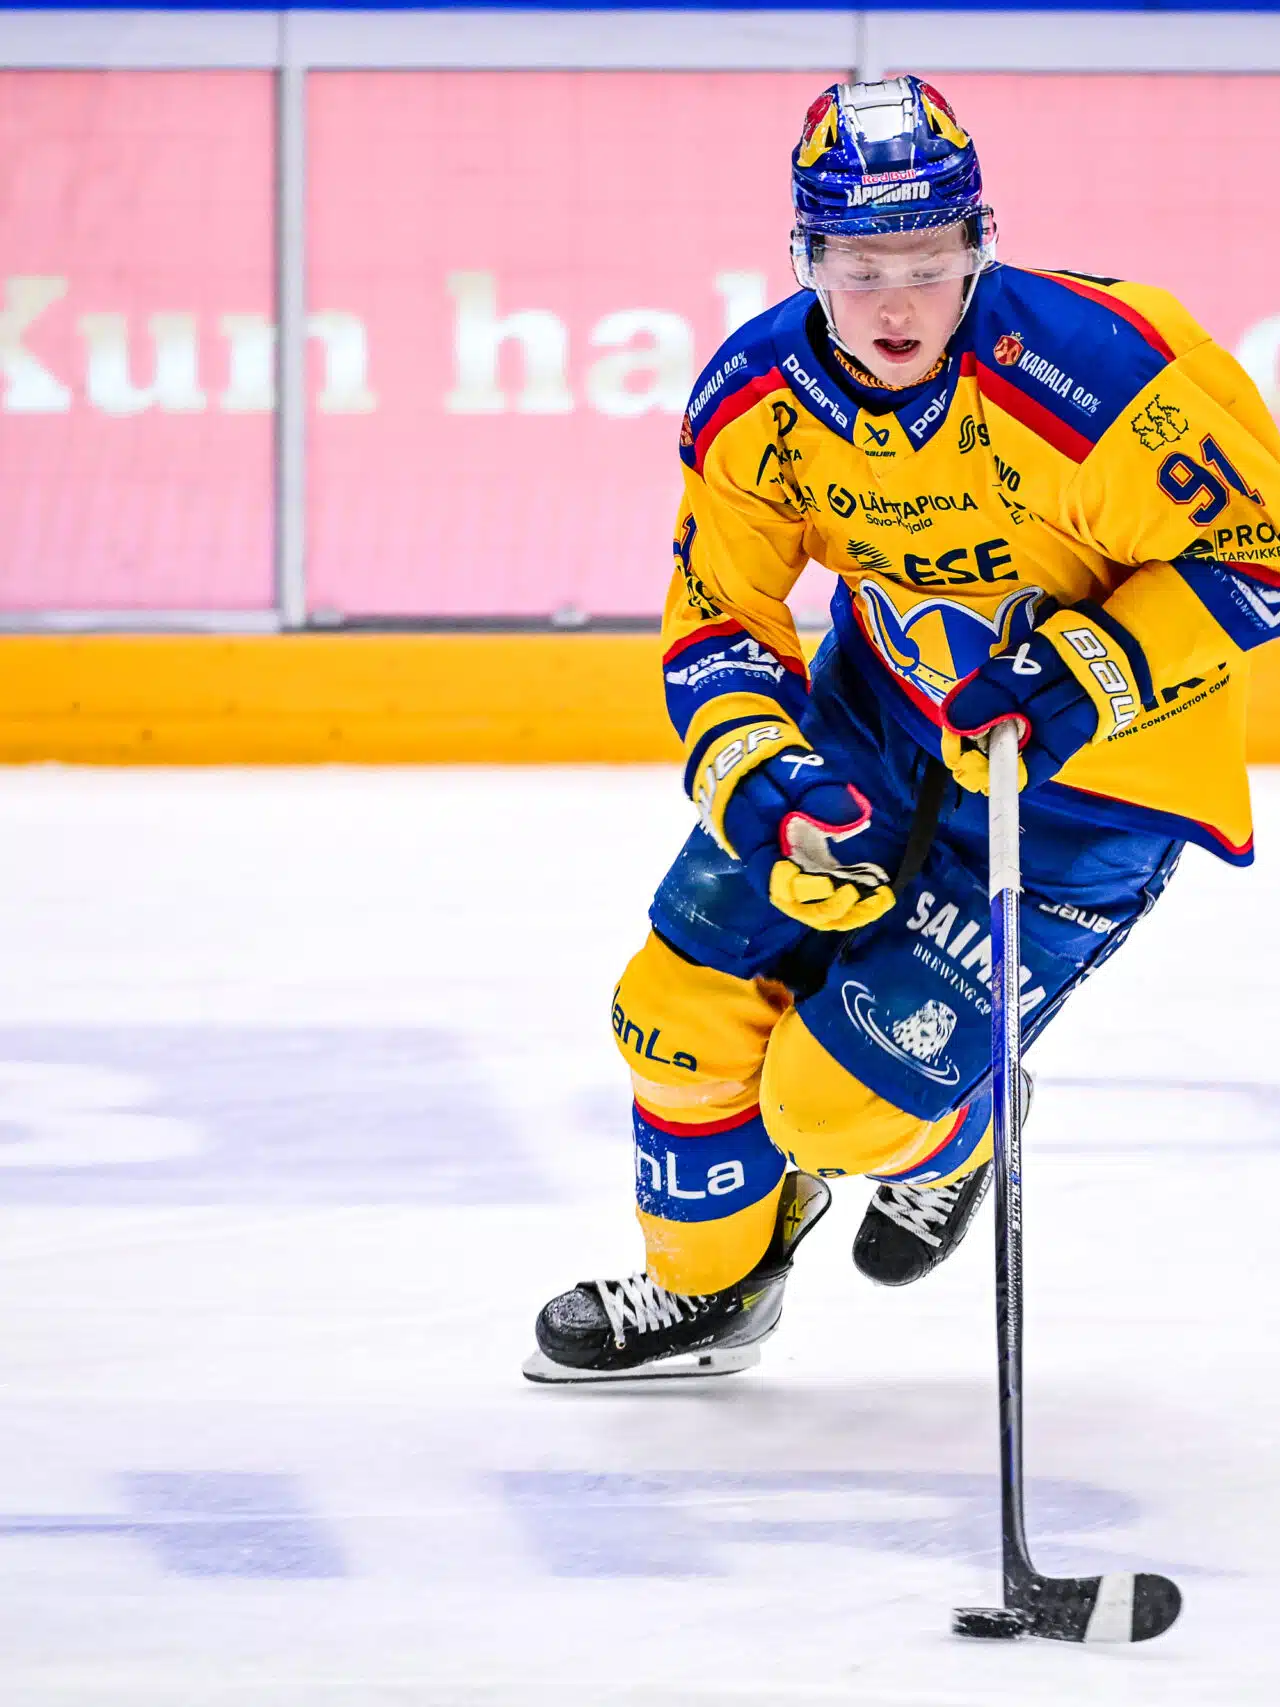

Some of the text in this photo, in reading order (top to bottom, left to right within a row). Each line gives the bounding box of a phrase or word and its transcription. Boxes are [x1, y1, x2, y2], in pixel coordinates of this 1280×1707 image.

[861, 167, 917, 186] Red Bull
[687, 370, 725, 422] KARJALA
[723, 351, 748, 374] 0.0%
[782, 353, 848, 430] polaria
[1018, 349, 1074, 398] KARJALA
[1072, 386, 1102, 414] 0.0%
[1156, 432, 1266, 527] 91
[903, 538, 1020, 587] ESE
[1107, 725, 1140, 743] STONE
[1140, 691, 1208, 730] CONSTRUCTION
[912, 942, 977, 1001] BREWING
